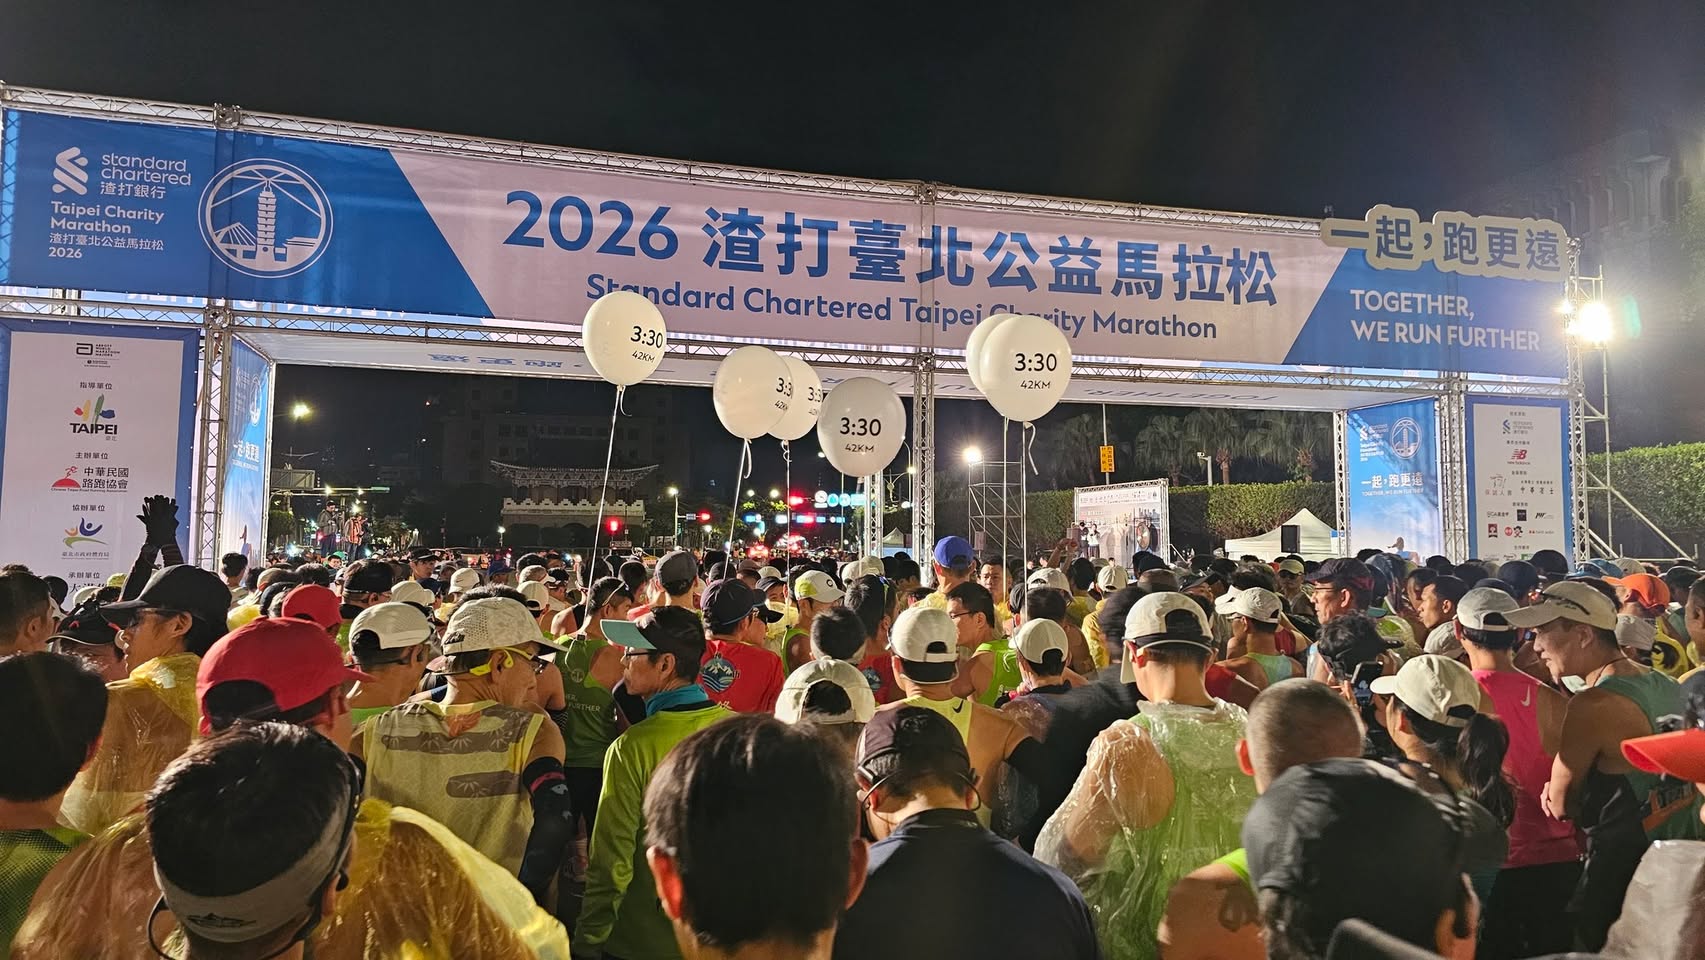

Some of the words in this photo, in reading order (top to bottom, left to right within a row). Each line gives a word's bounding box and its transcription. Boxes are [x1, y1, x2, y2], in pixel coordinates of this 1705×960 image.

[101, 153, 187, 172] standard
[101, 167, 191, 186] chartered
[100, 181, 166, 199] 渣打銀行
[51, 200, 101, 218] Taipei
[104, 205, 165, 224] Charity
[50, 216, 131, 234] Marathon
[502, 190, 679, 260] 2026
[49, 232, 164, 251] 渣打臺北公益馬拉松
[48, 246, 83, 259] 2026
[702, 206, 1278, 306] 渣打臺北公益馬拉松
[743, 287, 891, 321] Chartered
[899, 297, 983, 331] Taipei
[1093, 310, 1217, 339] Marathon
[1350, 289, 1475, 320] TOGETHER,
[630, 325, 664, 349] 3:30
[1350, 320, 1389, 343] WE
[1395, 322, 1441, 345] RUN
[1448, 328, 1540, 351] FURTHER
[632, 350, 656, 363] 42KM
[1014, 352, 1058, 372] 3:30
[776, 377, 793, 399] 3:3
[1020, 379, 1051, 390] 42KM
[69, 422, 118, 435] TAIPEI
[839, 416, 882, 437] 3:30
[845, 443, 875, 453] 42KM
[84, 466, 129, 478] 中華民國
[82, 478, 129, 489] 路跑協會
